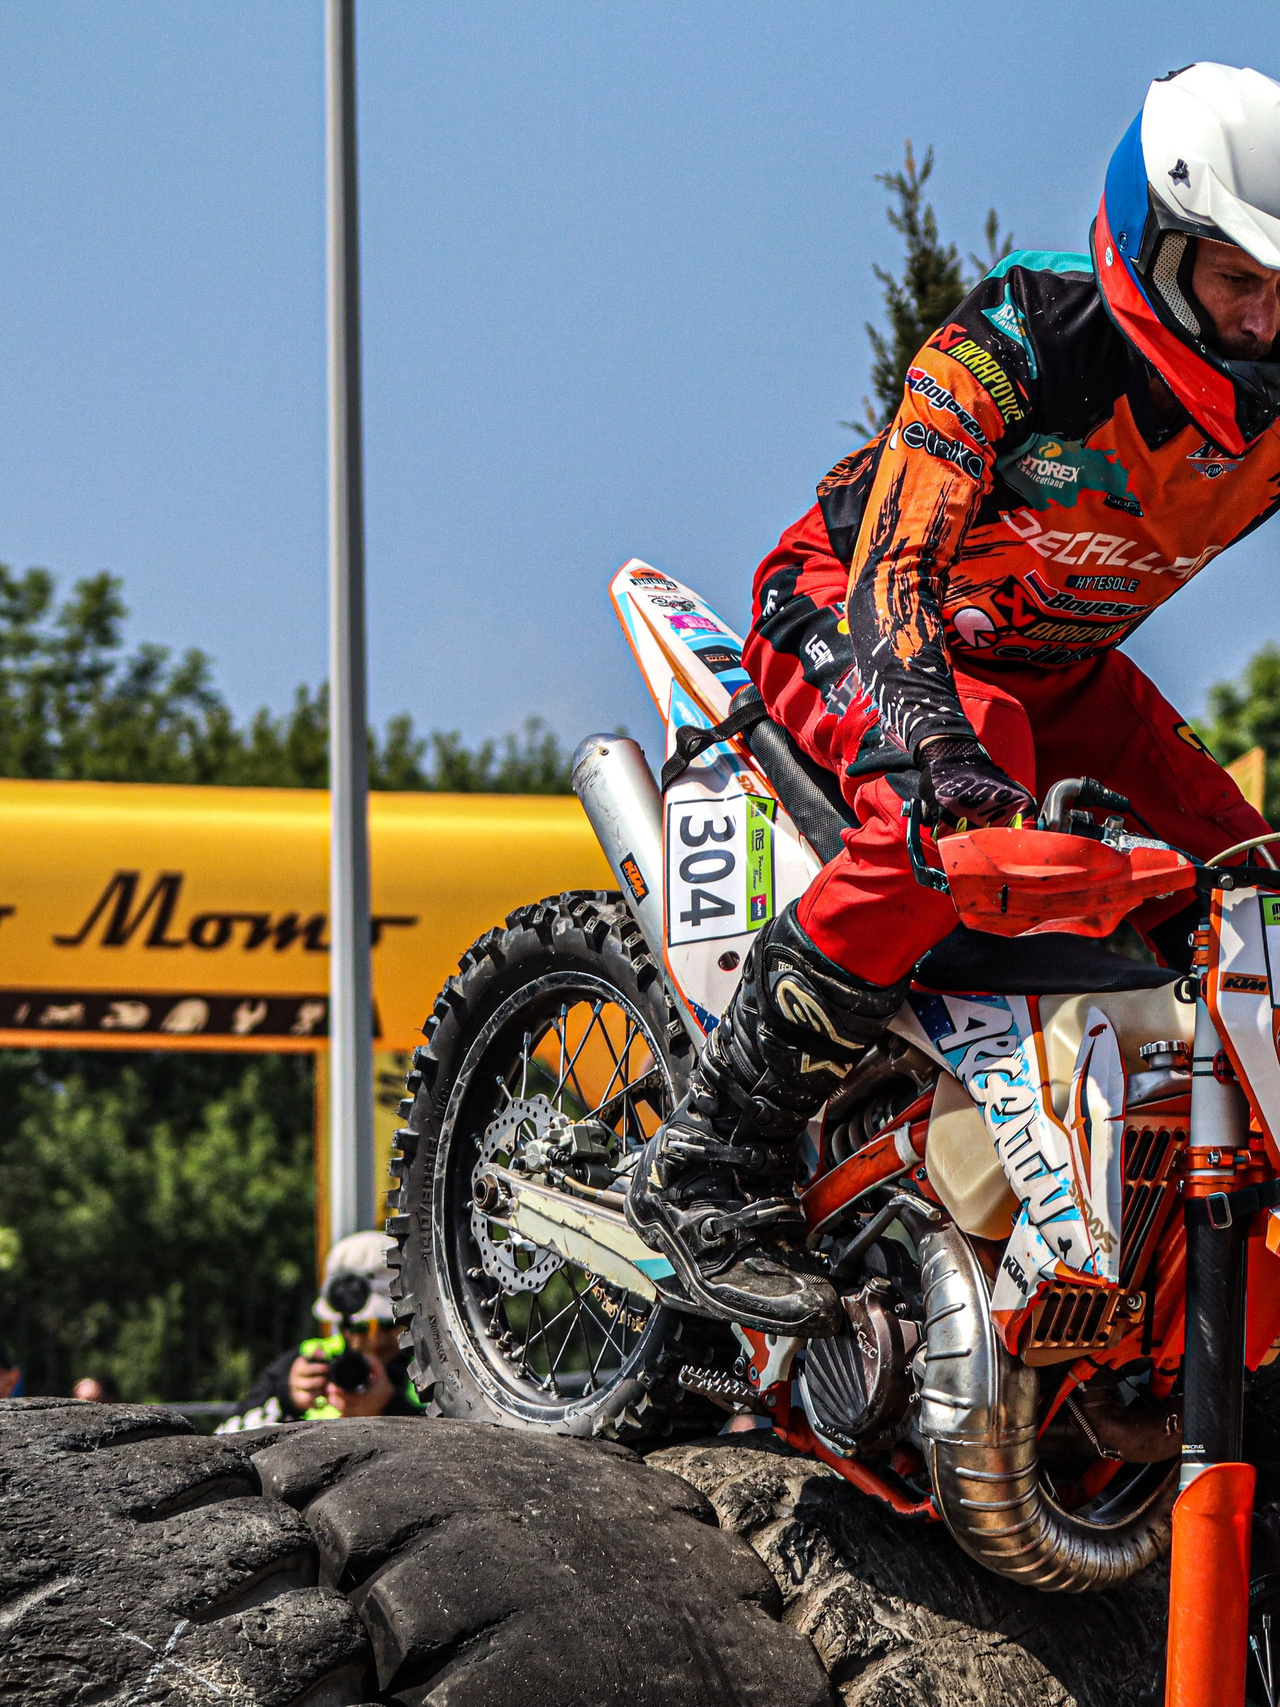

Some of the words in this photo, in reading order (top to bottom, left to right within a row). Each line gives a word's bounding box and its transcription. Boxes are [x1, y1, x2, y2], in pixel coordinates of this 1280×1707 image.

[914, 375, 989, 446] Boyesen
[1075, 577, 1139, 592] HYTESOLE
[623, 861, 645, 897] KTM
[679, 814, 736, 928] 304
[53, 869, 418, 952] Мот
[1223, 976, 1268, 992] KTM
[1002, 1253, 1027, 1295] KTM
